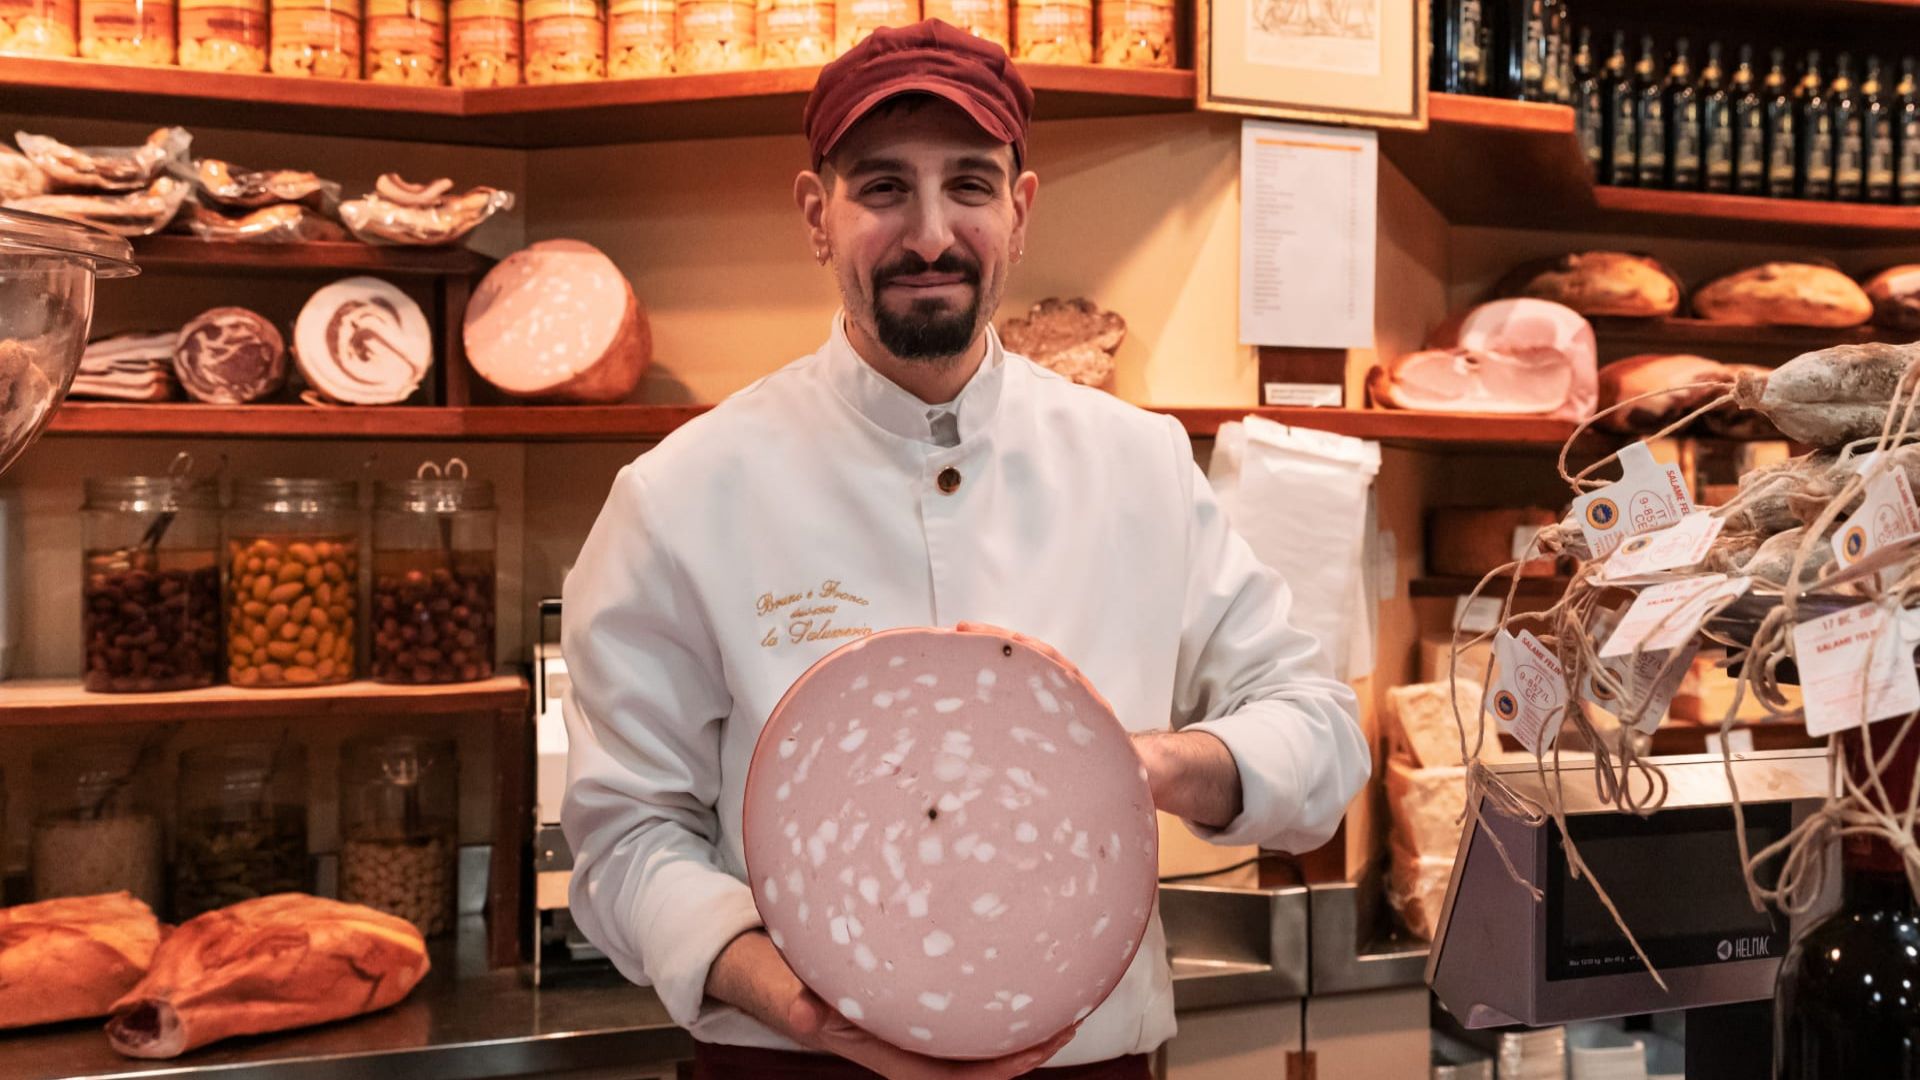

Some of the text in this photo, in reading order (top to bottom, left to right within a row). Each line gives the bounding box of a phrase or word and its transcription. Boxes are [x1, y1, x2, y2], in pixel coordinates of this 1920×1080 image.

[1666, 469, 1685, 501] SALAME
[1680, 499, 1690, 516] FEL
[1635, 514, 1649, 530] CE
[1656, 509, 1668, 520] IT
[819, 579, 869, 605] Franco
[761, 627, 778, 647] la
[1816, 636, 1853, 654] SALAME
[1521, 637, 1545, 661] SALAME
[1543, 656, 1562, 676] FELIN
[1534, 673, 1544, 682] IT
[1525, 687, 1538, 703] CE
[1735, 936, 1770, 958] HELMAC
